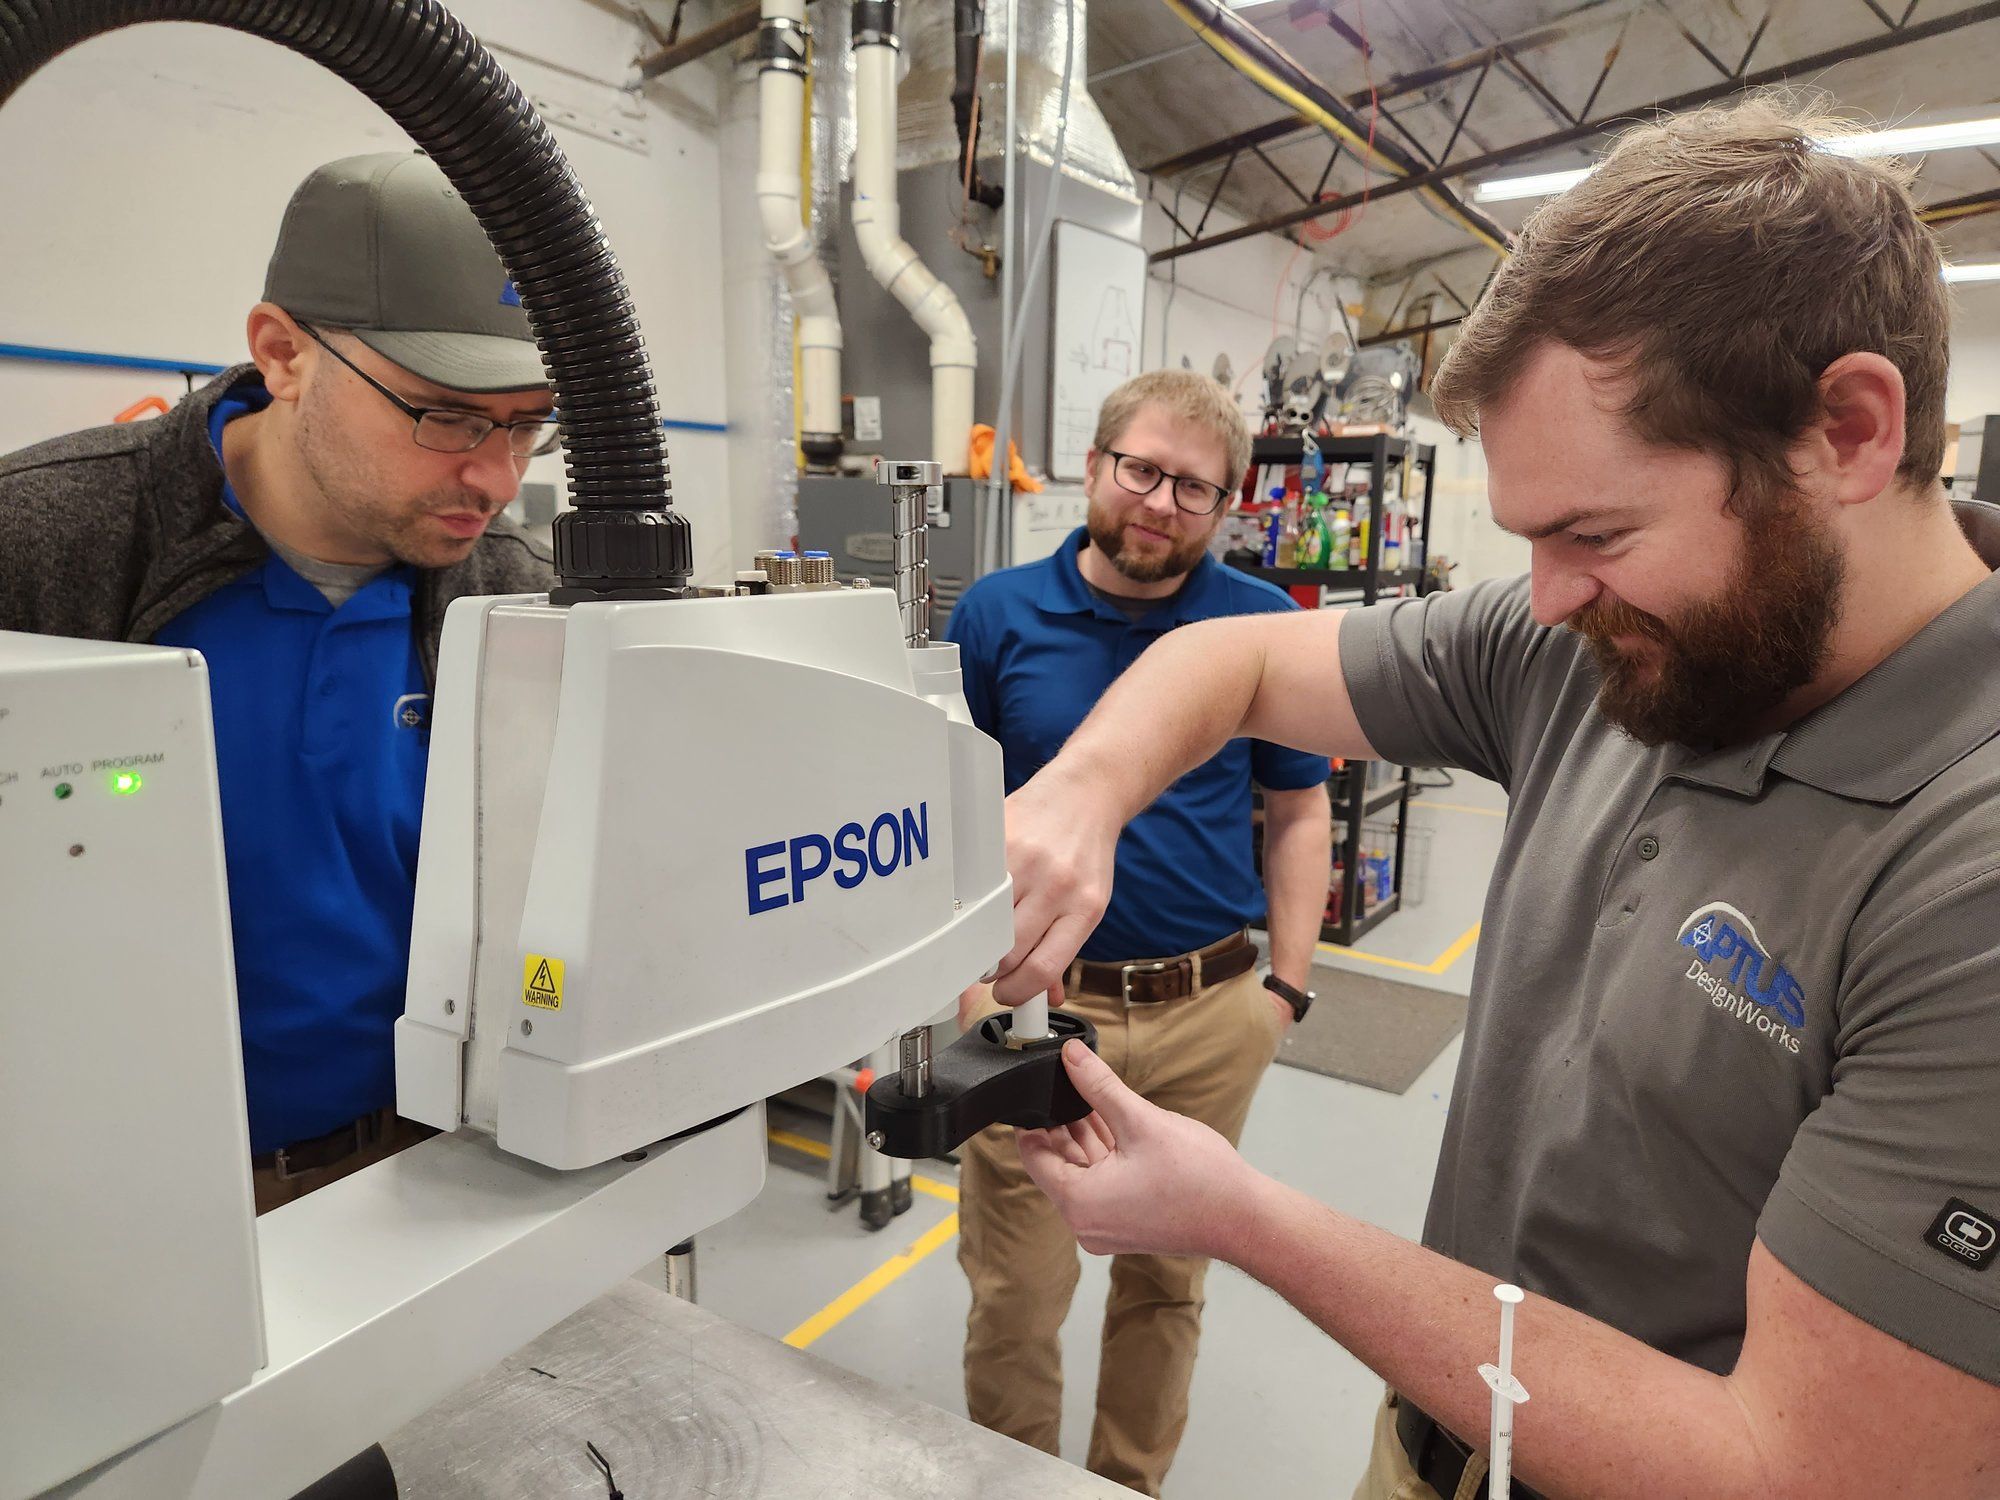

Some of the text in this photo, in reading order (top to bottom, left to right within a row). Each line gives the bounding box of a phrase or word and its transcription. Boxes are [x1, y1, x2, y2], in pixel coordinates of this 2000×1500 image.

[42, 763, 84, 777] AUTO
[92, 753, 165, 771] PROGRAM
[745, 801, 929, 915] EPSON
[524, 989, 559, 1008] WARNING
[1685, 959, 1801, 1054] DesignWorks
